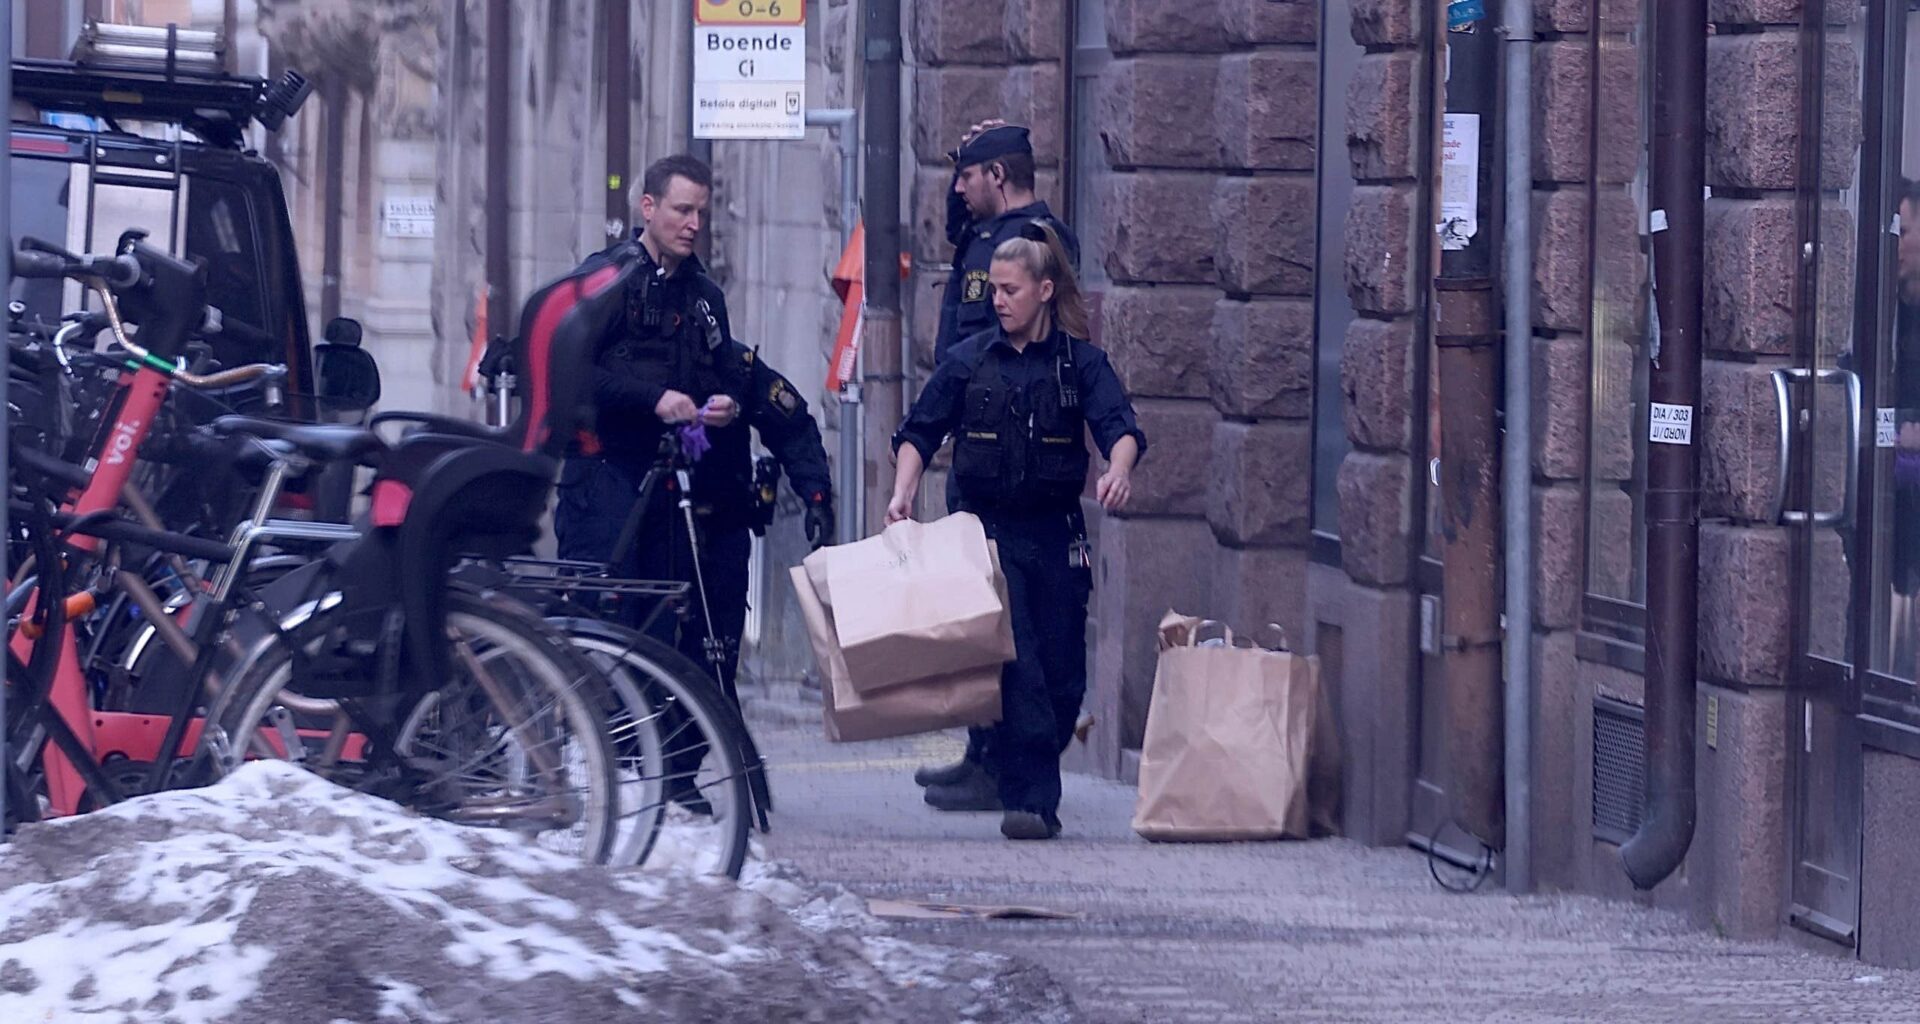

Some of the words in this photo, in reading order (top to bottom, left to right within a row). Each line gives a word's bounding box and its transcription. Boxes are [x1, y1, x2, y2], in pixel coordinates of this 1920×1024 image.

[707, 33, 792, 50] Boende
[700, 98, 735, 109] Betala
[739, 98, 777, 111] digitalt
[1653, 407, 1666, 420] DIA
[1673, 409, 1689, 421] 303
